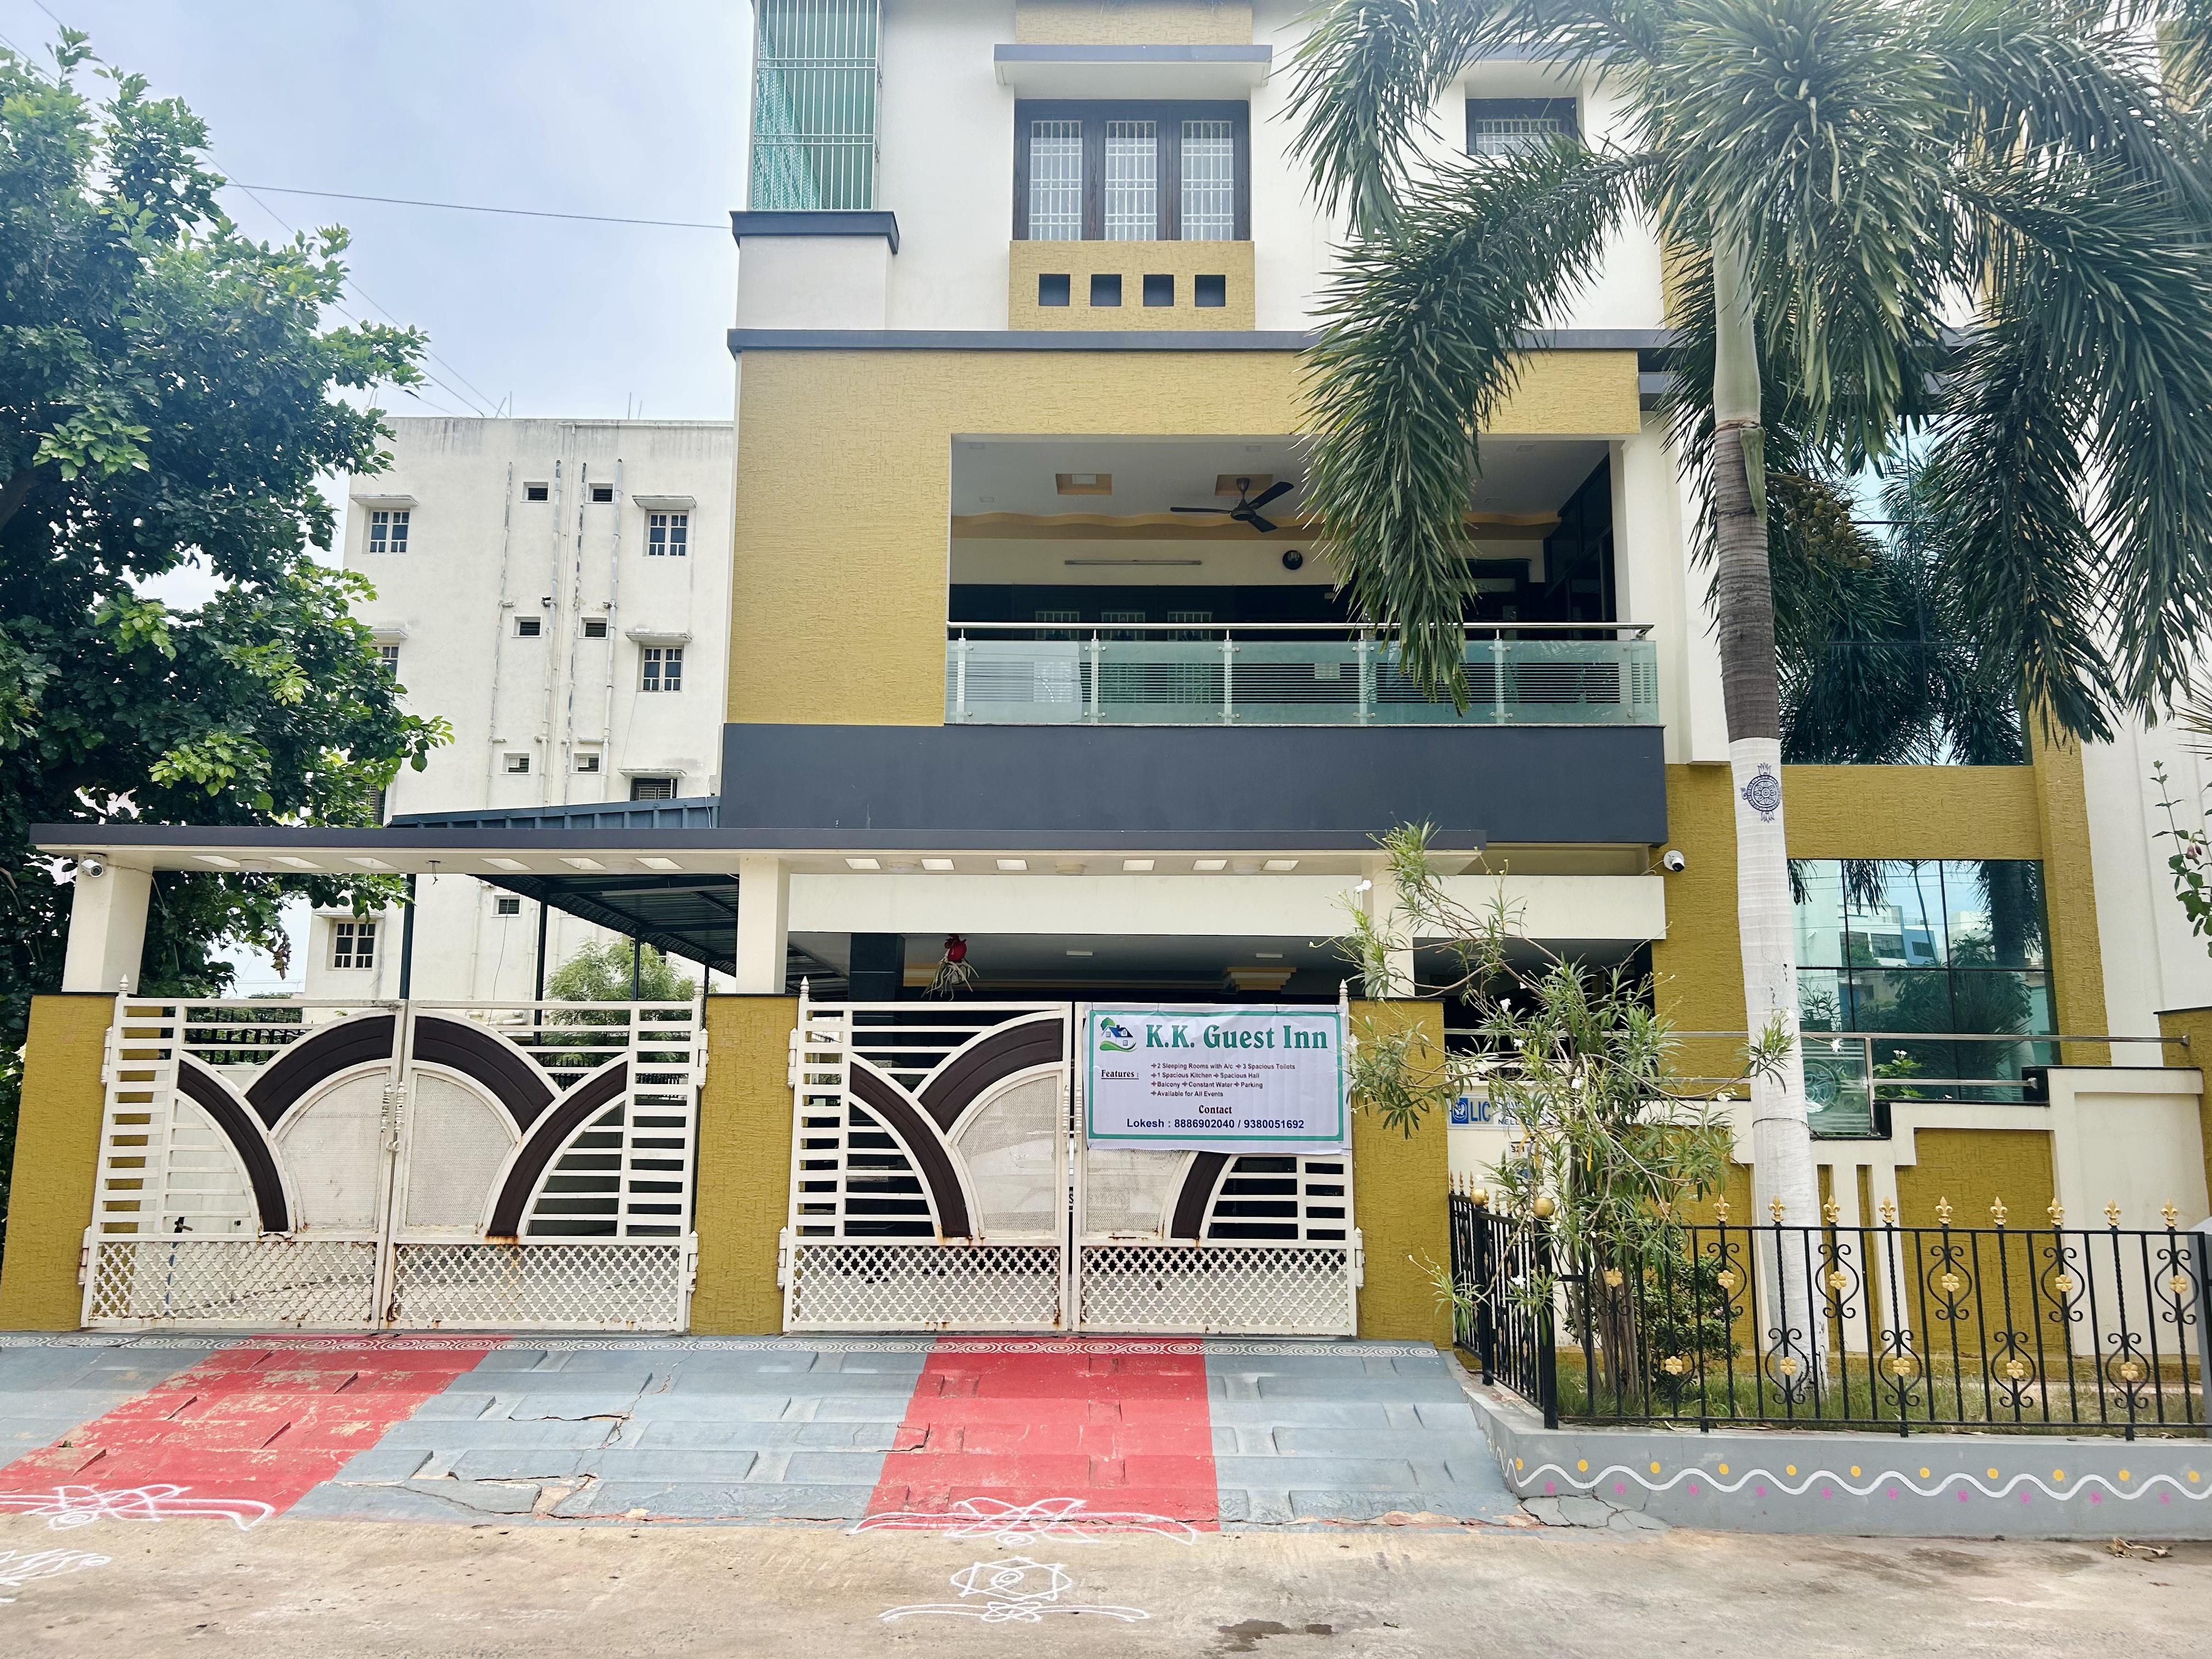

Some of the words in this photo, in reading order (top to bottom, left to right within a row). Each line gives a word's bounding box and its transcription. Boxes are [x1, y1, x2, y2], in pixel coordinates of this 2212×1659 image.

[1146, 1024, 1195, 1048] K.K.
[1203, 1024, 1276, 1048] Guest
[1283, 1025, 1328, 1048] Inn
[1101, 1069, 1135, 1078] Features
[1198, 1104, 1232, 1114] Contact
[1470, 1101, 1491, 1122] LIC
[1127, 1118, 1164, 1128] Lokesh
[1174, 1119, 1235, 1128] 8886902040
[1244, 1119, 1305, 1129] 9380051692
